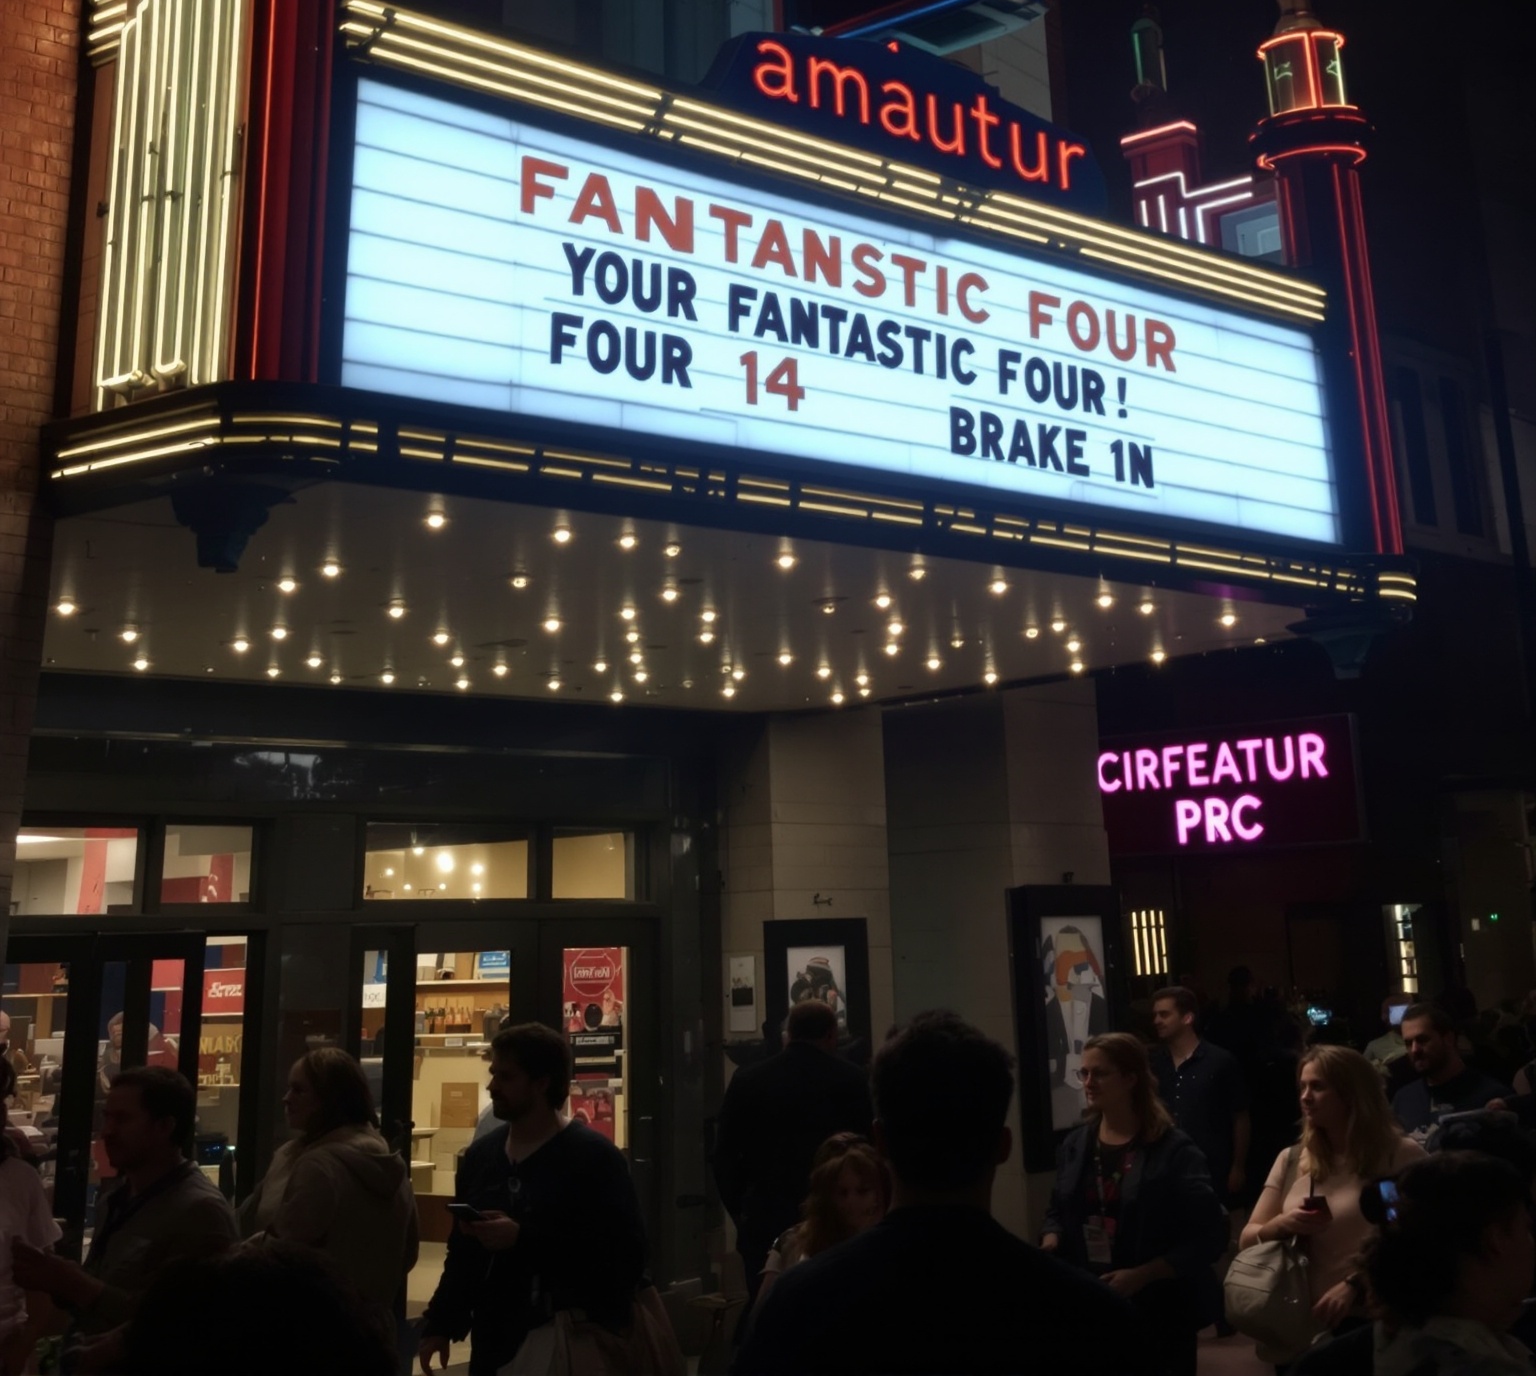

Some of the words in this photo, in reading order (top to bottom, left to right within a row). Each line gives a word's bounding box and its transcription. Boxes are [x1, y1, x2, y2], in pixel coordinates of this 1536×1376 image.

[755, 40, 1085, 190] amautur
[520, 155, 990, 324] FANTANSTIC
[1028, 290, 1177, 373] FOUR
[562, 242, 698, 322] YOUR
[728, 283, 978, 386] FANTASTIC
[550, 311, 693, 389] FOUR
[739, 350, 806, 412] 14
[949, 406, 1091, 478] BRAKE
[1097, 732, 1329, 793] CIRFEATUR
[1175, 794, 1265, 845] PRC
